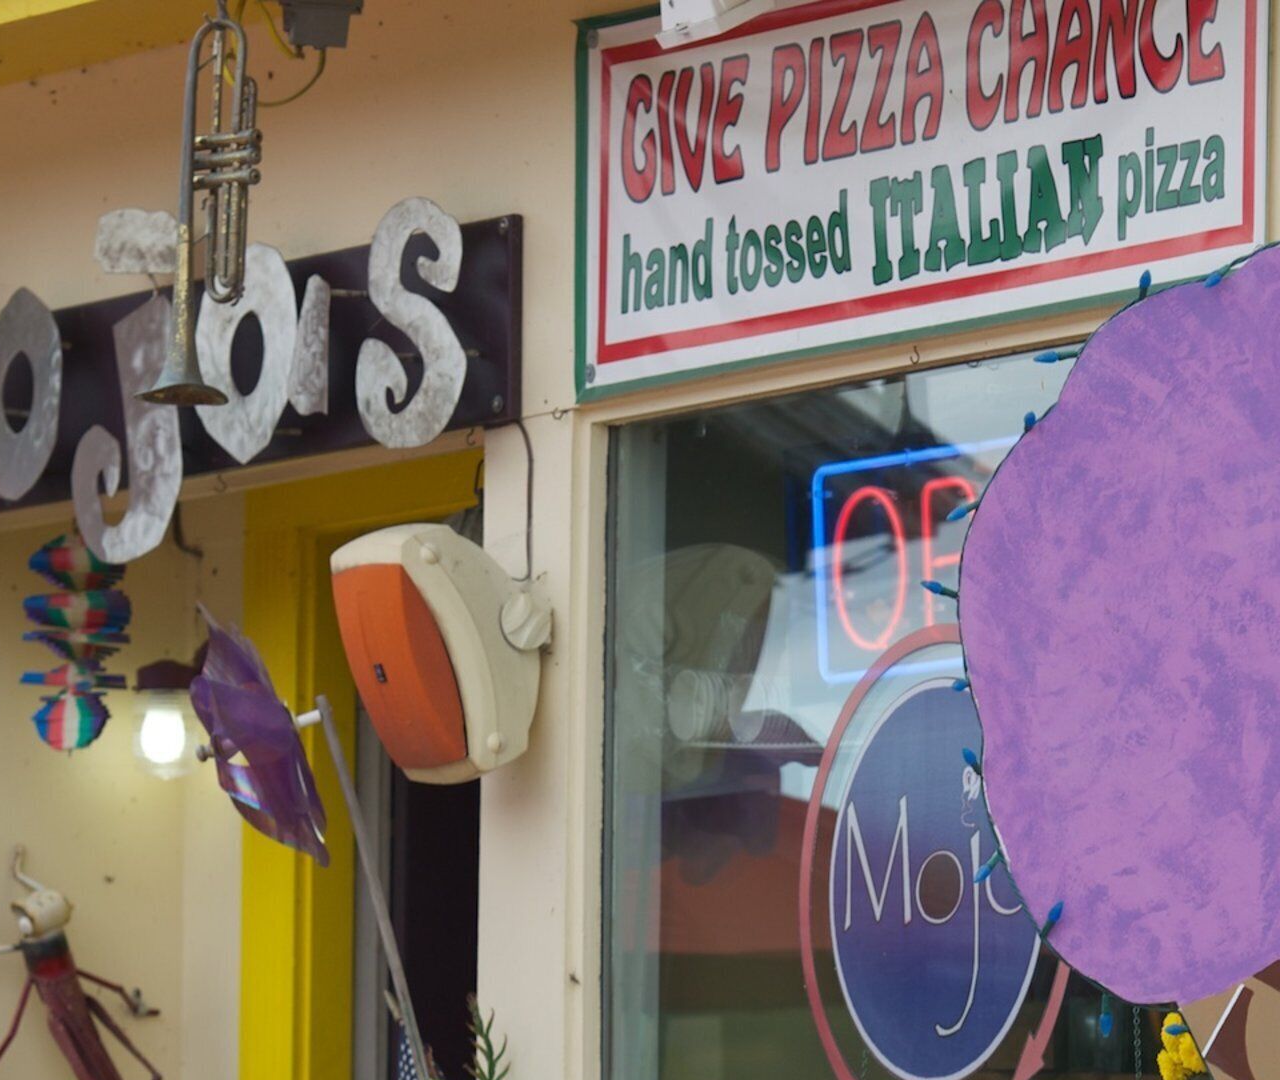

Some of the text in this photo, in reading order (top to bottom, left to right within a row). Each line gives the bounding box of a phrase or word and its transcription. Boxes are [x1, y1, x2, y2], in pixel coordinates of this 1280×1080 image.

[622, 0, 1226, 203] GIVE PIZZA CHANCE
[621, 127, 1227, 314] hand tossed ITALIAN pizza
